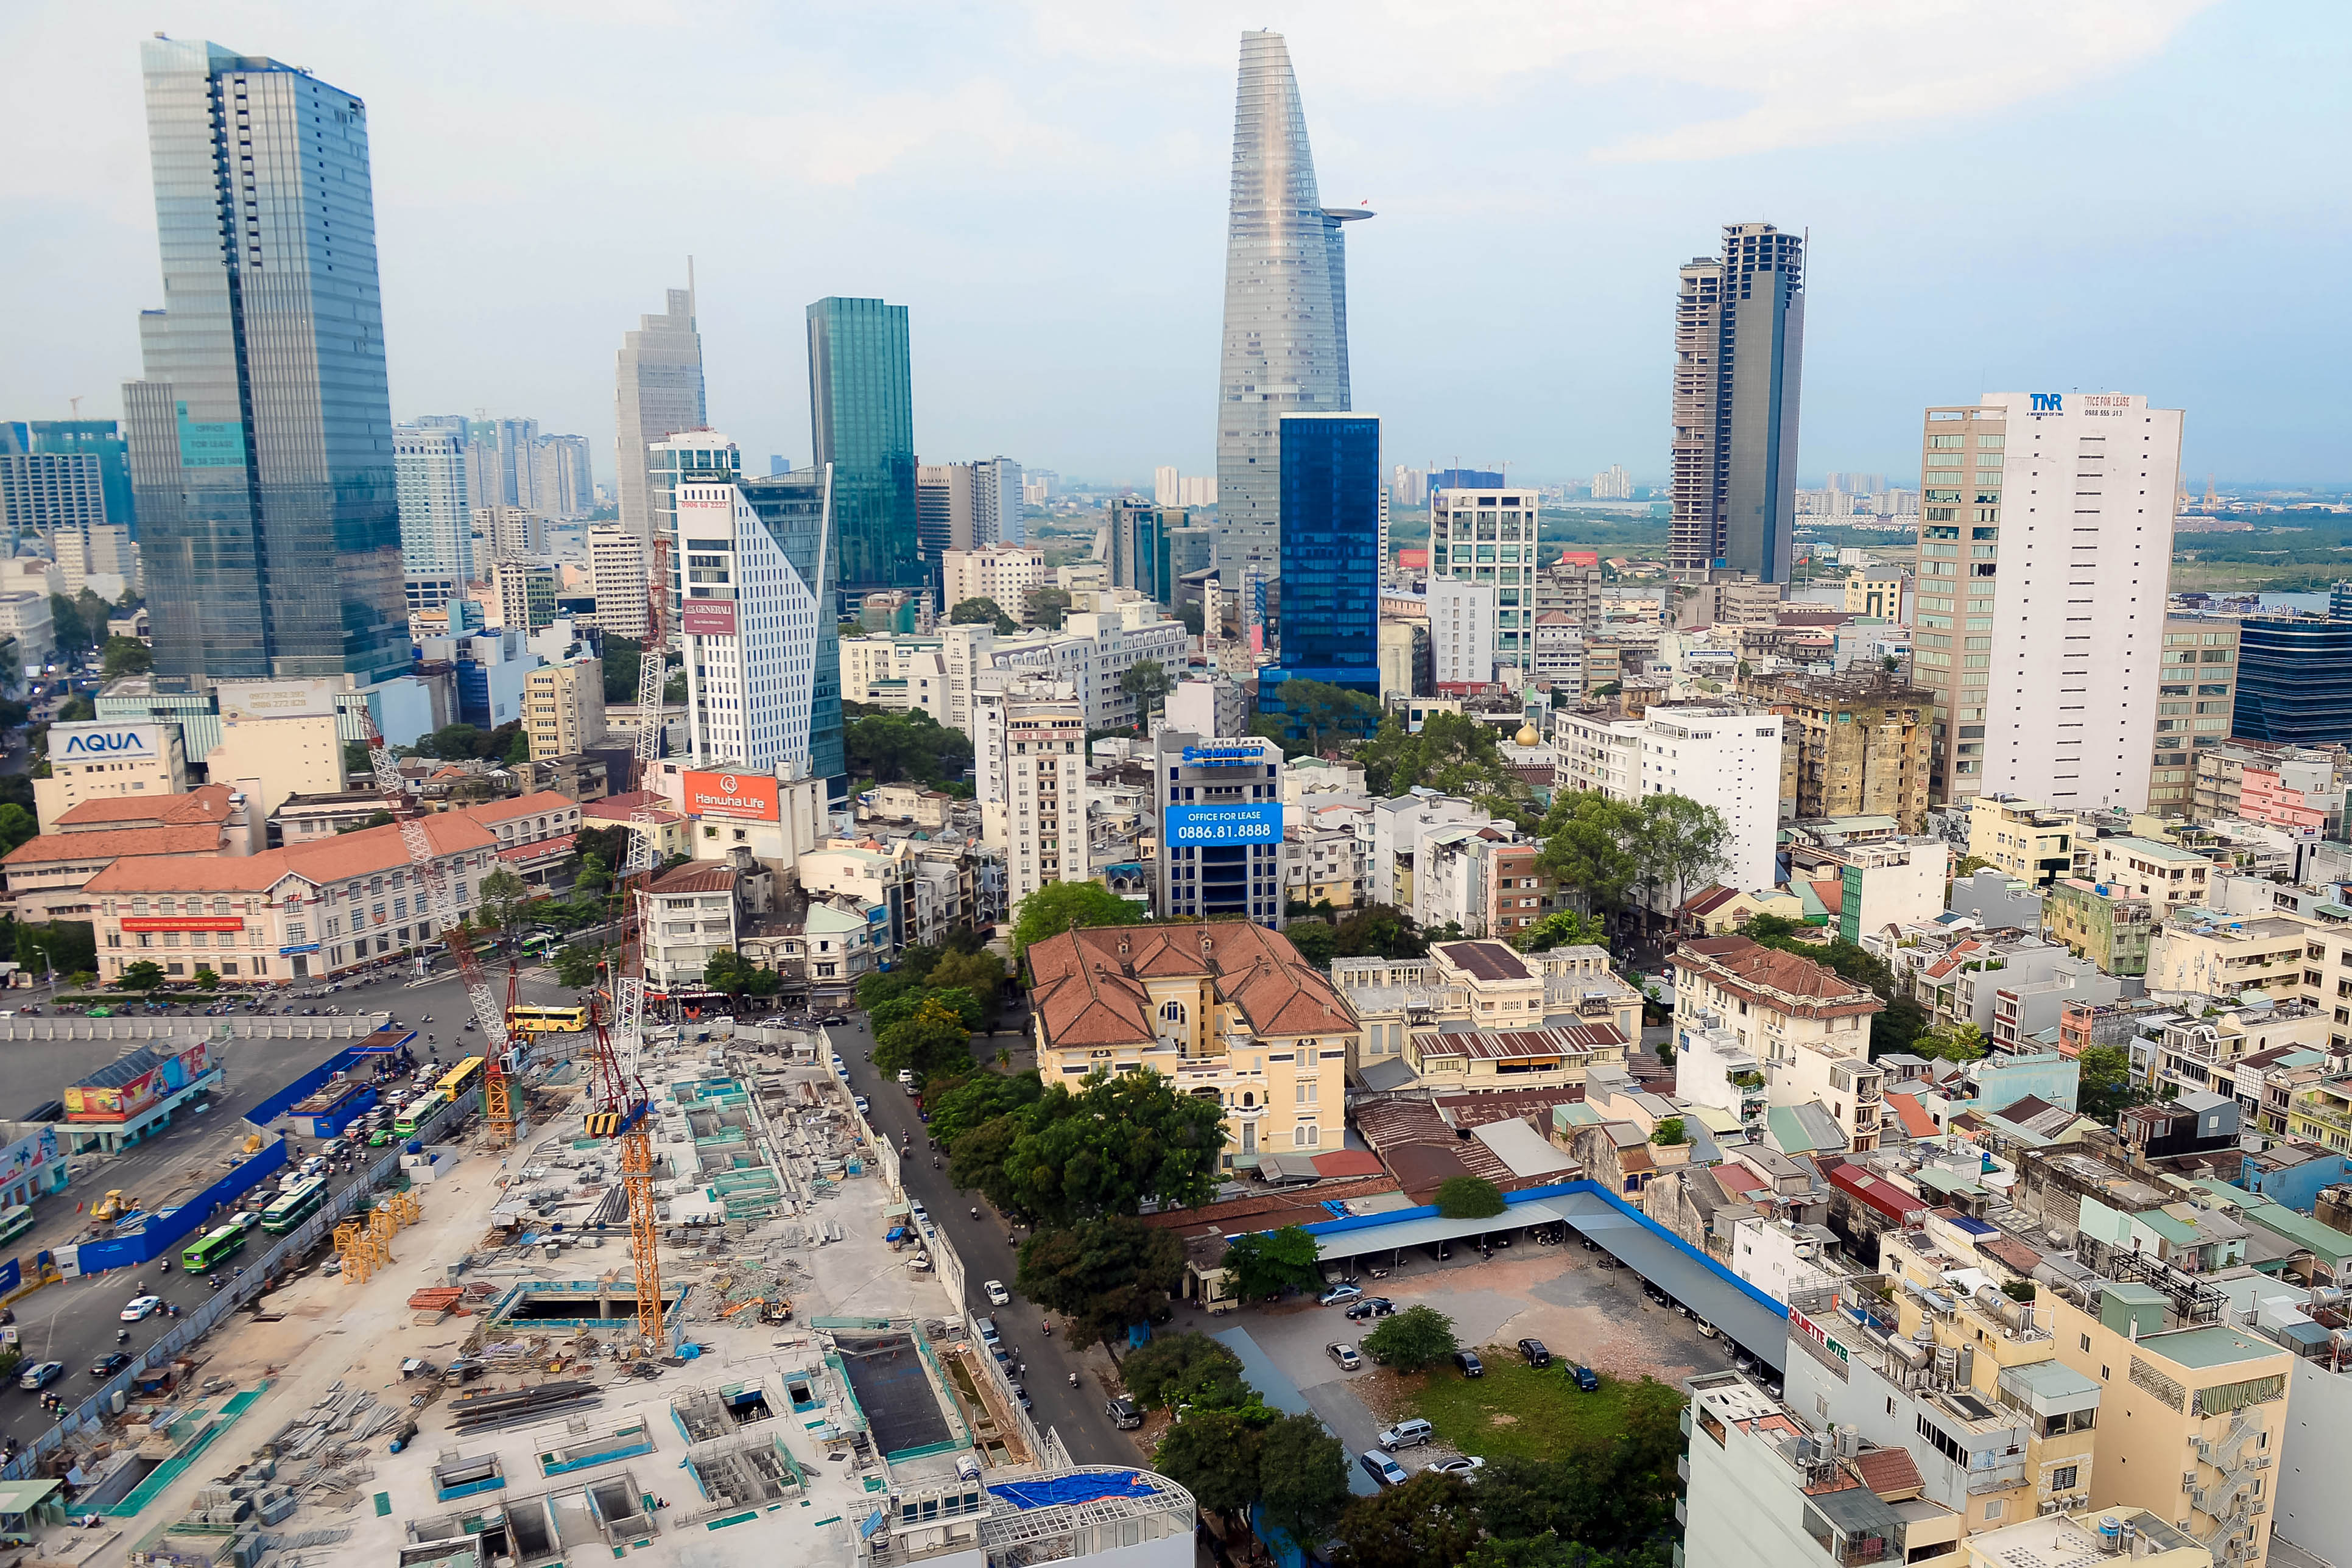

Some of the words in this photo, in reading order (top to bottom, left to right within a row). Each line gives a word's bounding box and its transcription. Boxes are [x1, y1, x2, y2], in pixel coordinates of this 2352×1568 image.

[2030, 394, 2062, 411] TNR
[2100, 397, 2111, 406] FOR
[2113, 397, 2130, 407] LEASE
[695, 605, 731, 614] GENERALI
[66, 733, 143, 753] AQUA
[1182, 746, 1265, 761] Sacomreal
[695, 793, 742, 807] Hanwha
[744, 797, 765, 809] Life
[1238, 811, 1261, 820] LEASE
[1178, 824, 1270, 839] 0886.81.8888
[1789, 1307, 1825, 1345] CALMETTE
[1826, 1337, 1848, 1363] HOTEL
